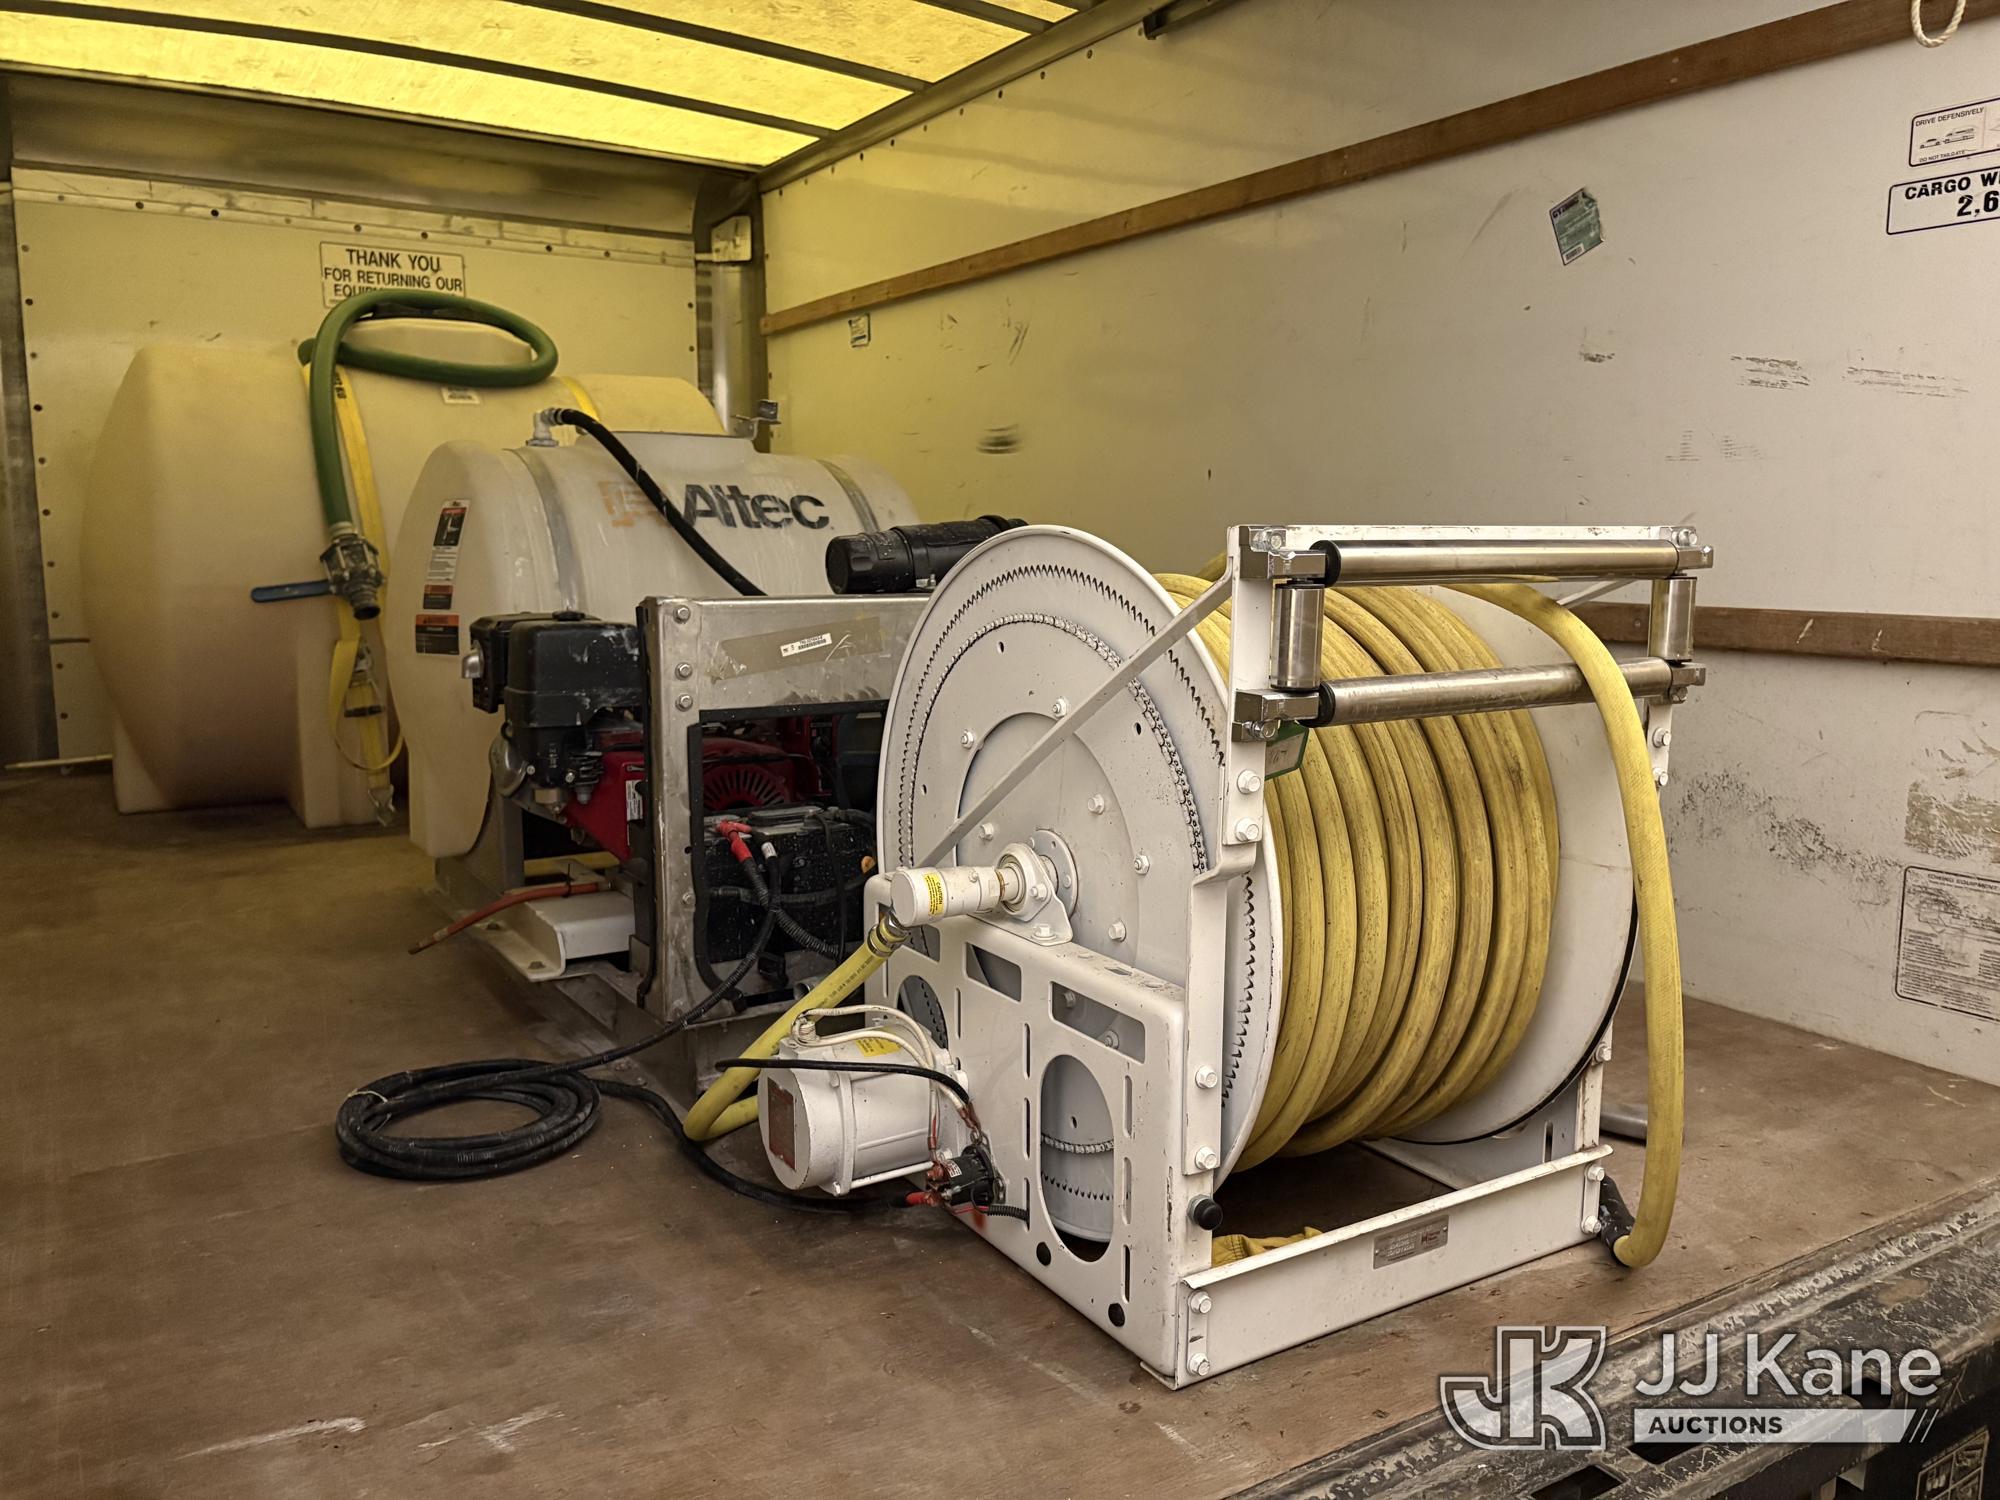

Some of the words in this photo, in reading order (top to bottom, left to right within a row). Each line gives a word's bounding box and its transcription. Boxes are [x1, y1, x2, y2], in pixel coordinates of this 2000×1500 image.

[1915, 117, 1936, 127] DRIVE
[1937, 107, 1984, 122] DEFENSIVELY
[1905, 176, 1971, 200] CARGO
[1957, 190, 2000, 217] 2,6
[346, 248, 402, 269] THANK
[408, 254, 441, 273] YOU
[324, 267, 351, 282] FOR
[357, 270, 431, 289] RETURNING
[436, 277, 463, 291] OUR
[333, 283, 383, 298] EQUIP
[683, 483, 830, 530] Altec
